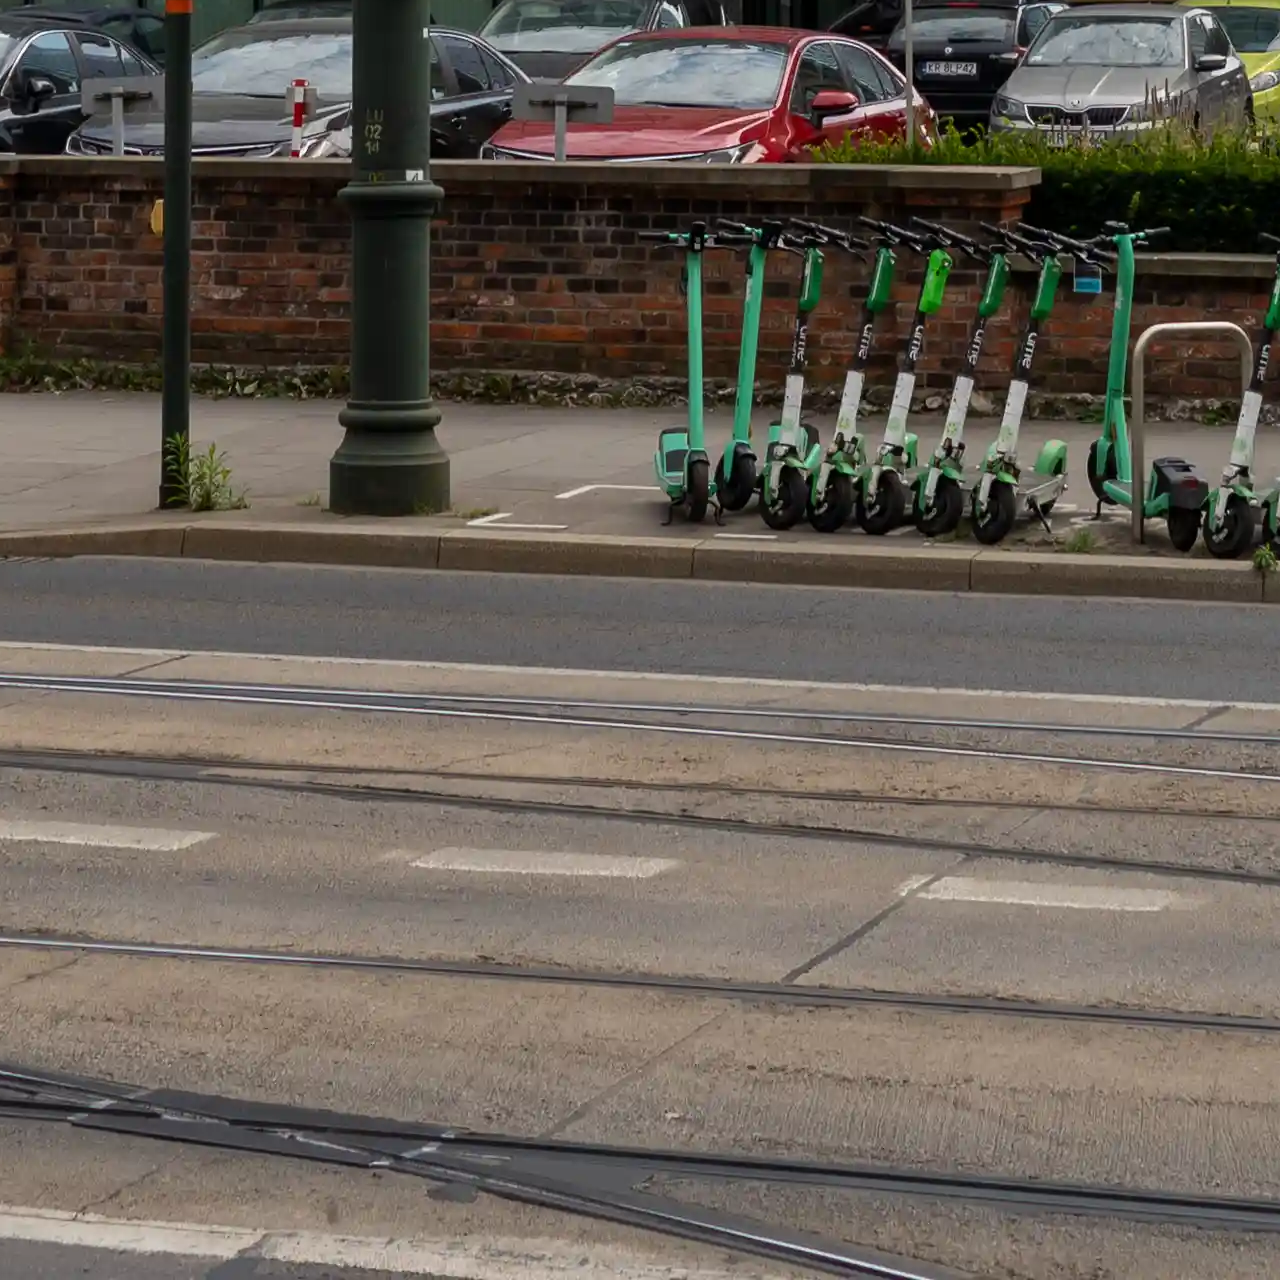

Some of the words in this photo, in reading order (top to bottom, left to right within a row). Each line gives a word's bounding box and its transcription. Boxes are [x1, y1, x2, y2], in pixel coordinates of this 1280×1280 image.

[797, 325, 808, 362] Lime
[859, 323, 873, 360] Lime
[909, 325, 924, 360] Lime
[968, 329, 984, 366] Lime
[1022, 332, 1038, 369] Lime
[1256, 344, 1271, 381] Lime
